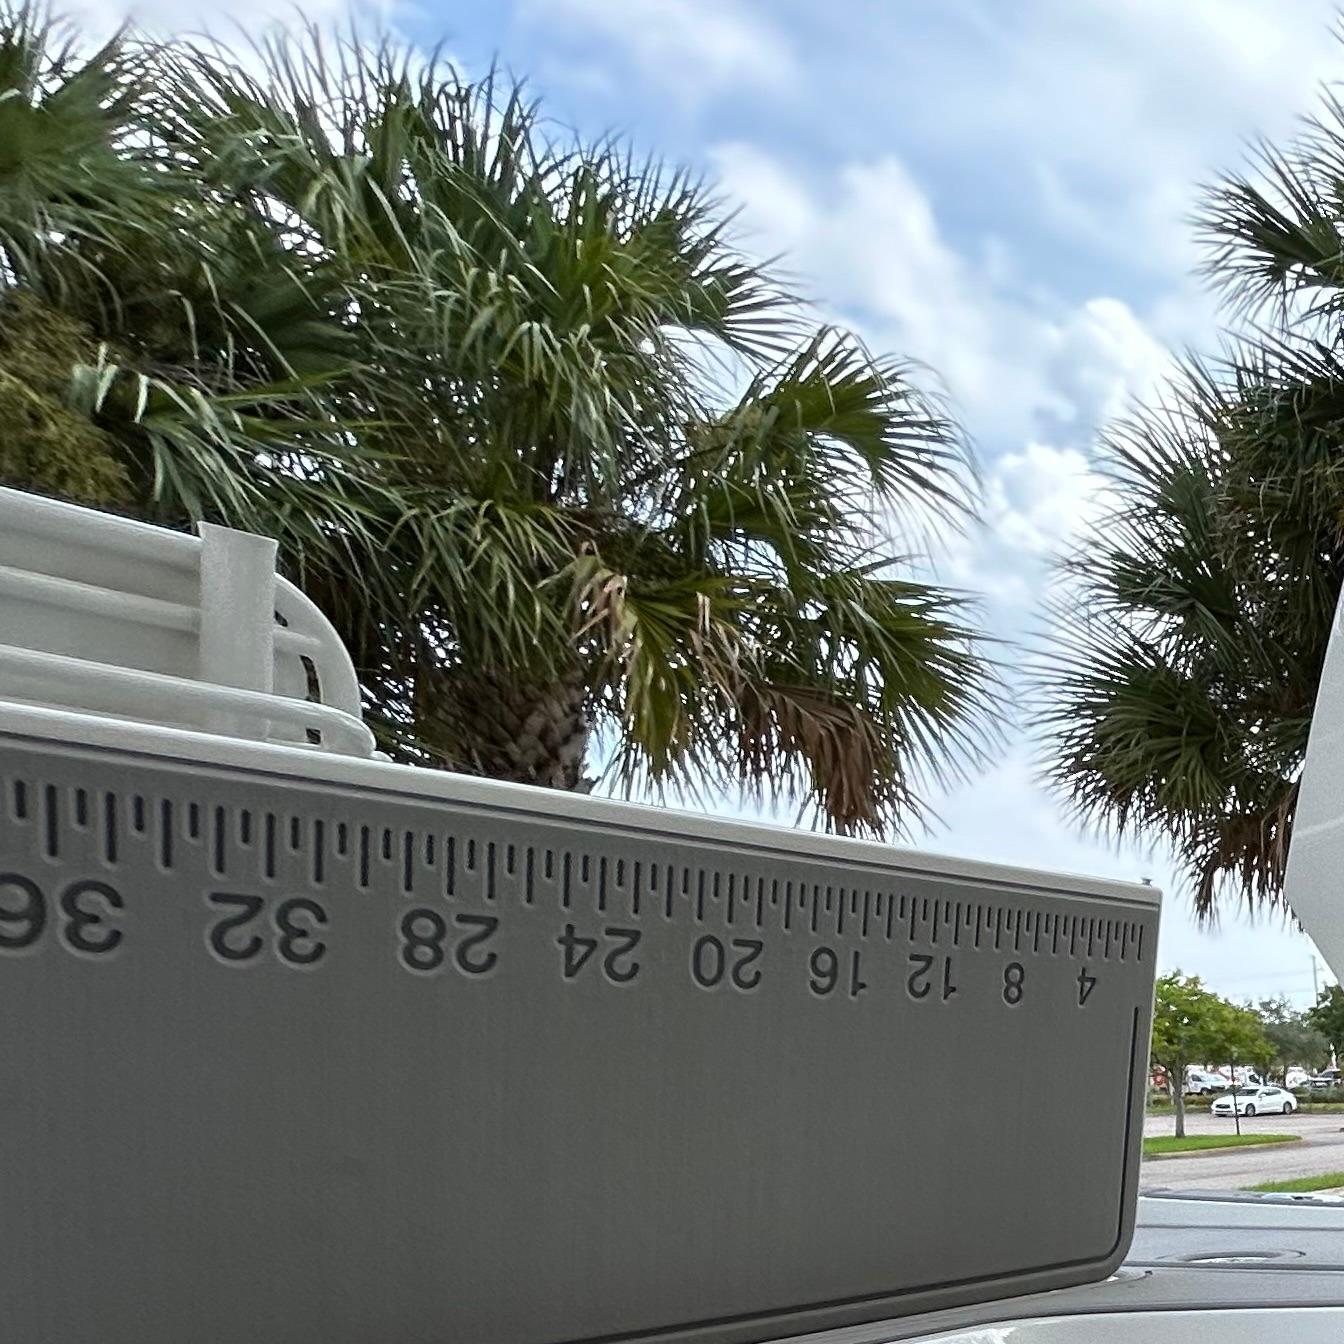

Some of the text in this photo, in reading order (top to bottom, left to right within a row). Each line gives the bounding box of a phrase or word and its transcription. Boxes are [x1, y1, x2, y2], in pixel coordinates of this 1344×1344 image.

[0, 872, 1097, 1005] 4 8 12 16 20 24 28 32 36
